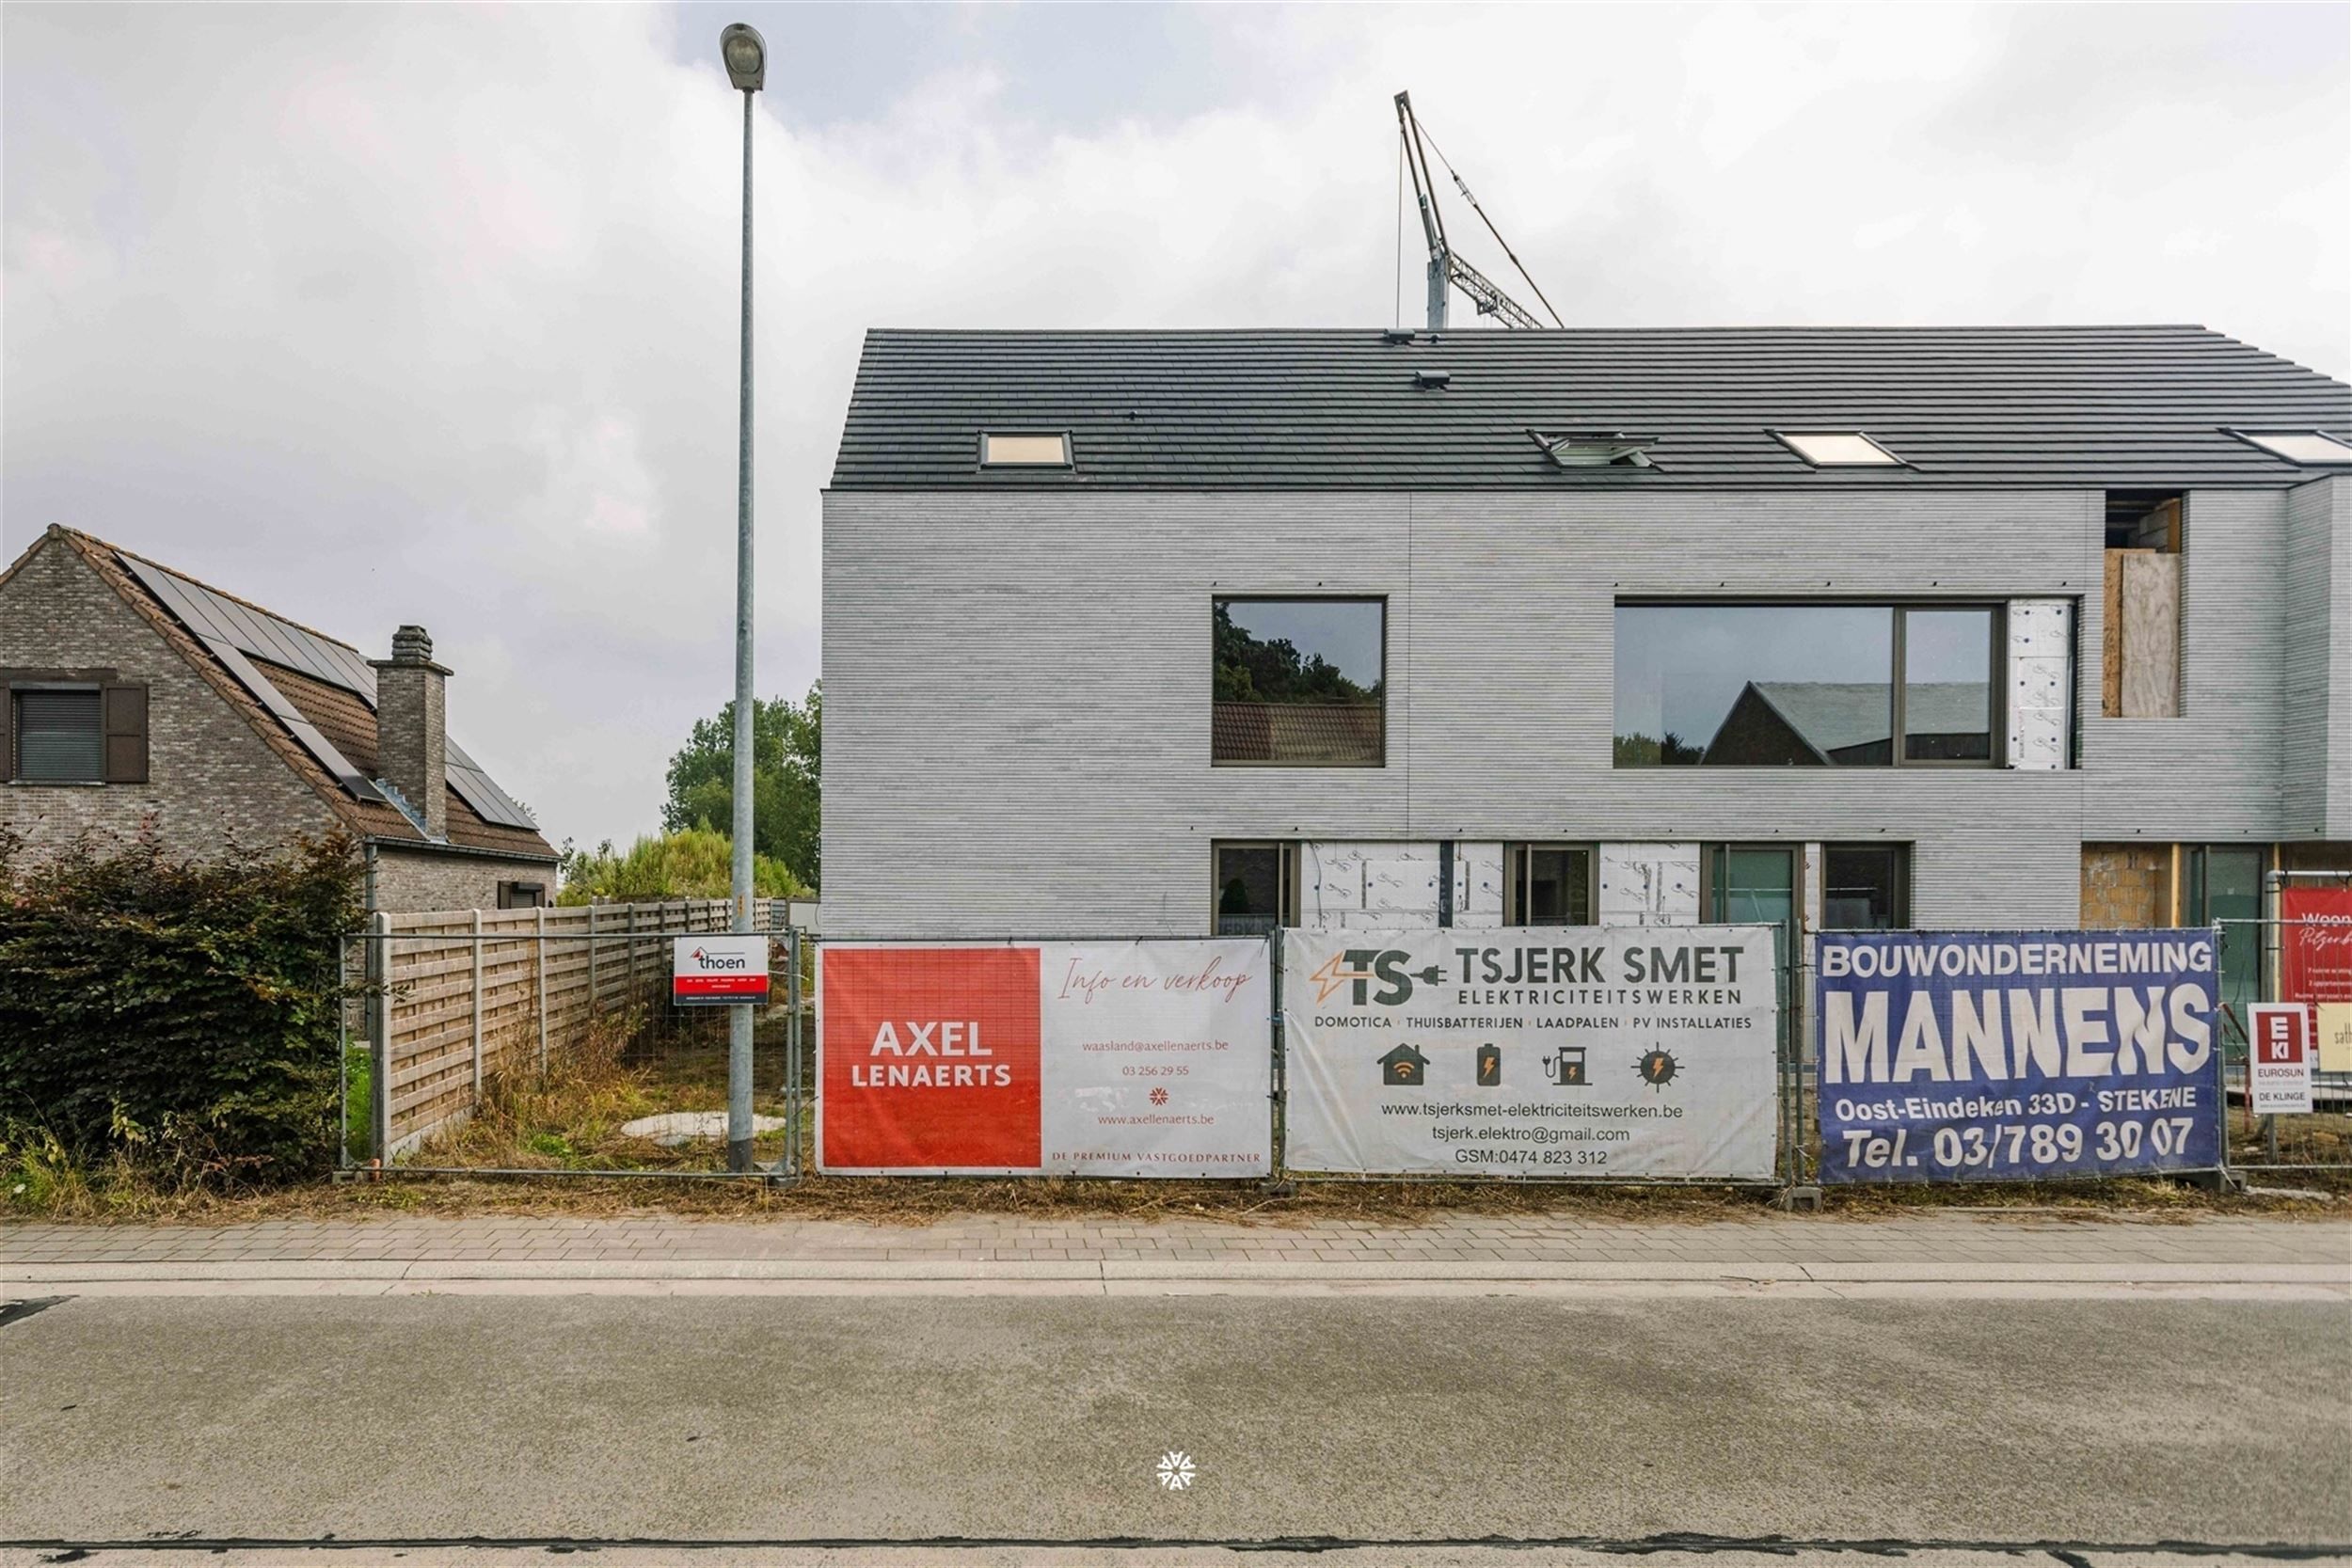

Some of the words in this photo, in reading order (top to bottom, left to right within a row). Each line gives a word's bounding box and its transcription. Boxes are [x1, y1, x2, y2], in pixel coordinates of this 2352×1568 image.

[698, 955, 745, 969] thoen
[1455, 947, 1606, 984] TSJERK
[1623, 946, 1744, 983] SMET
[1822, 941, 2212, 978] BOUWONDERNEMING
[1057, 958, 1117, 1004] Info
[1122, 974, 1157, 989] en
[1164, 956, 1253, 1003] verkoop
[1343, 949, 1413, 1006] TS
[1458, 990, 1741, 1005] ELEKTRICITEITSWERKEN
[1315, 1016, 1391, 1028] DOMOTICA
[1406, 1017, 1522, 1029] THUISBATTERIJEN
[1536, 1017, 1618, 1028] LAADPALEN
[1633, 1018, 1651, 1028] PV
[1657, 1018, 1752, 1029] INSTALLATIES
[870, 1022, 993, 1056] AXEL
[1825, 983, 2211, 1084] MANNENS
[1083, 1039, 1229, 1052] waasland@axellenaerts.be
[852, 1065, 1011, 1086] LENAERTS
[1122, 1066, 1136, 1076] 03
[1138, 1066, 1158, 1076] 256
[1160, 1066, 1174, 1076] 29
[1176, 1066, 1189, 1076] 55
[2258, 1069, 2304, 1078] EUROSUN
[1836, 1095, 2022, 1121] Oost-Eindeken
[2028, 1092, 2075, 1116] 33D
[2099, 1086, 2197, 1113] STEKENE
[2259, 1093, 2271, 1101] DE
[2273, 1092, 2305, 1101] KLINGE
[1381, 1102, 1683, 1118] www.tsjerksmet-elektriciteitswerken.be
[1098, 1114, 1215, 1125] www.axellenaerts.be
[1432, 1126, 1630, 1144] tsjerk.elektro@gmail.com
[1842, 1129, 1917, 1168] Tel.
[1933, 1122, 2083, 1168] 03/789
[2095, 1120, 2143, 1162] 30
[2151, 1117, 2194, 1157] 07
[1052, 1152, 1067, 1161] DE
[1073, 1152, 1131, 1162] PREMIUM
[1136, 1152, 1261, 1163] VASTGOEDPARTNER
[1455, 1149, 1538, 1164] GSM:0474
[1543, 1150, 1572, 1164] 823
[1578, 1150, 1608, 1164] 312
